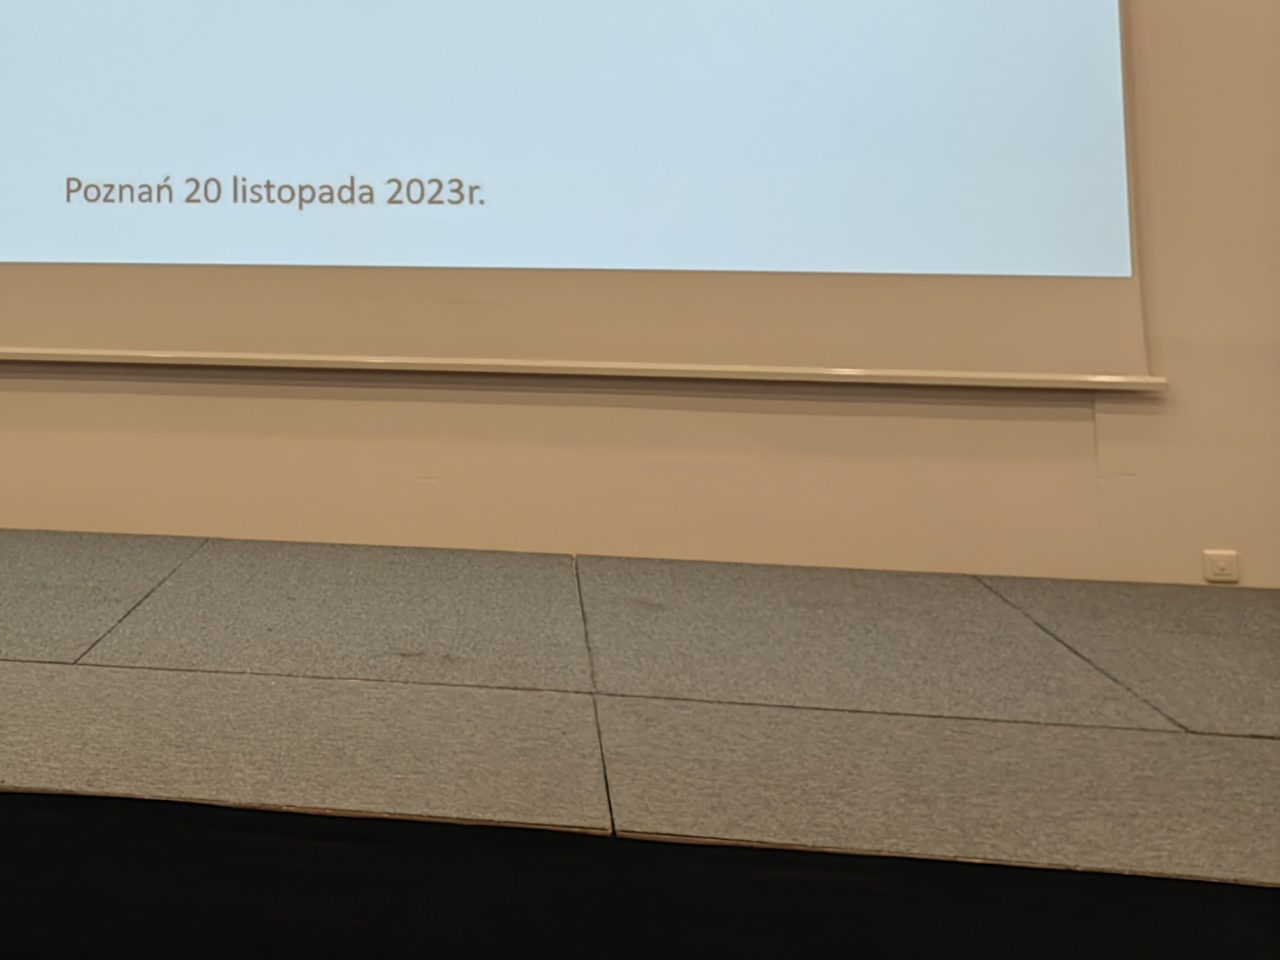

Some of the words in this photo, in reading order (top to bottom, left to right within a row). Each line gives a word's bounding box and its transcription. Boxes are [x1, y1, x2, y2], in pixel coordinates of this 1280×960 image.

[65, 175, 174, 204] Poznań
[184, 177, 223, 204] 20
[232, 174, 375, 212] listopada
[386, 177, 486, 206] 2023r.
